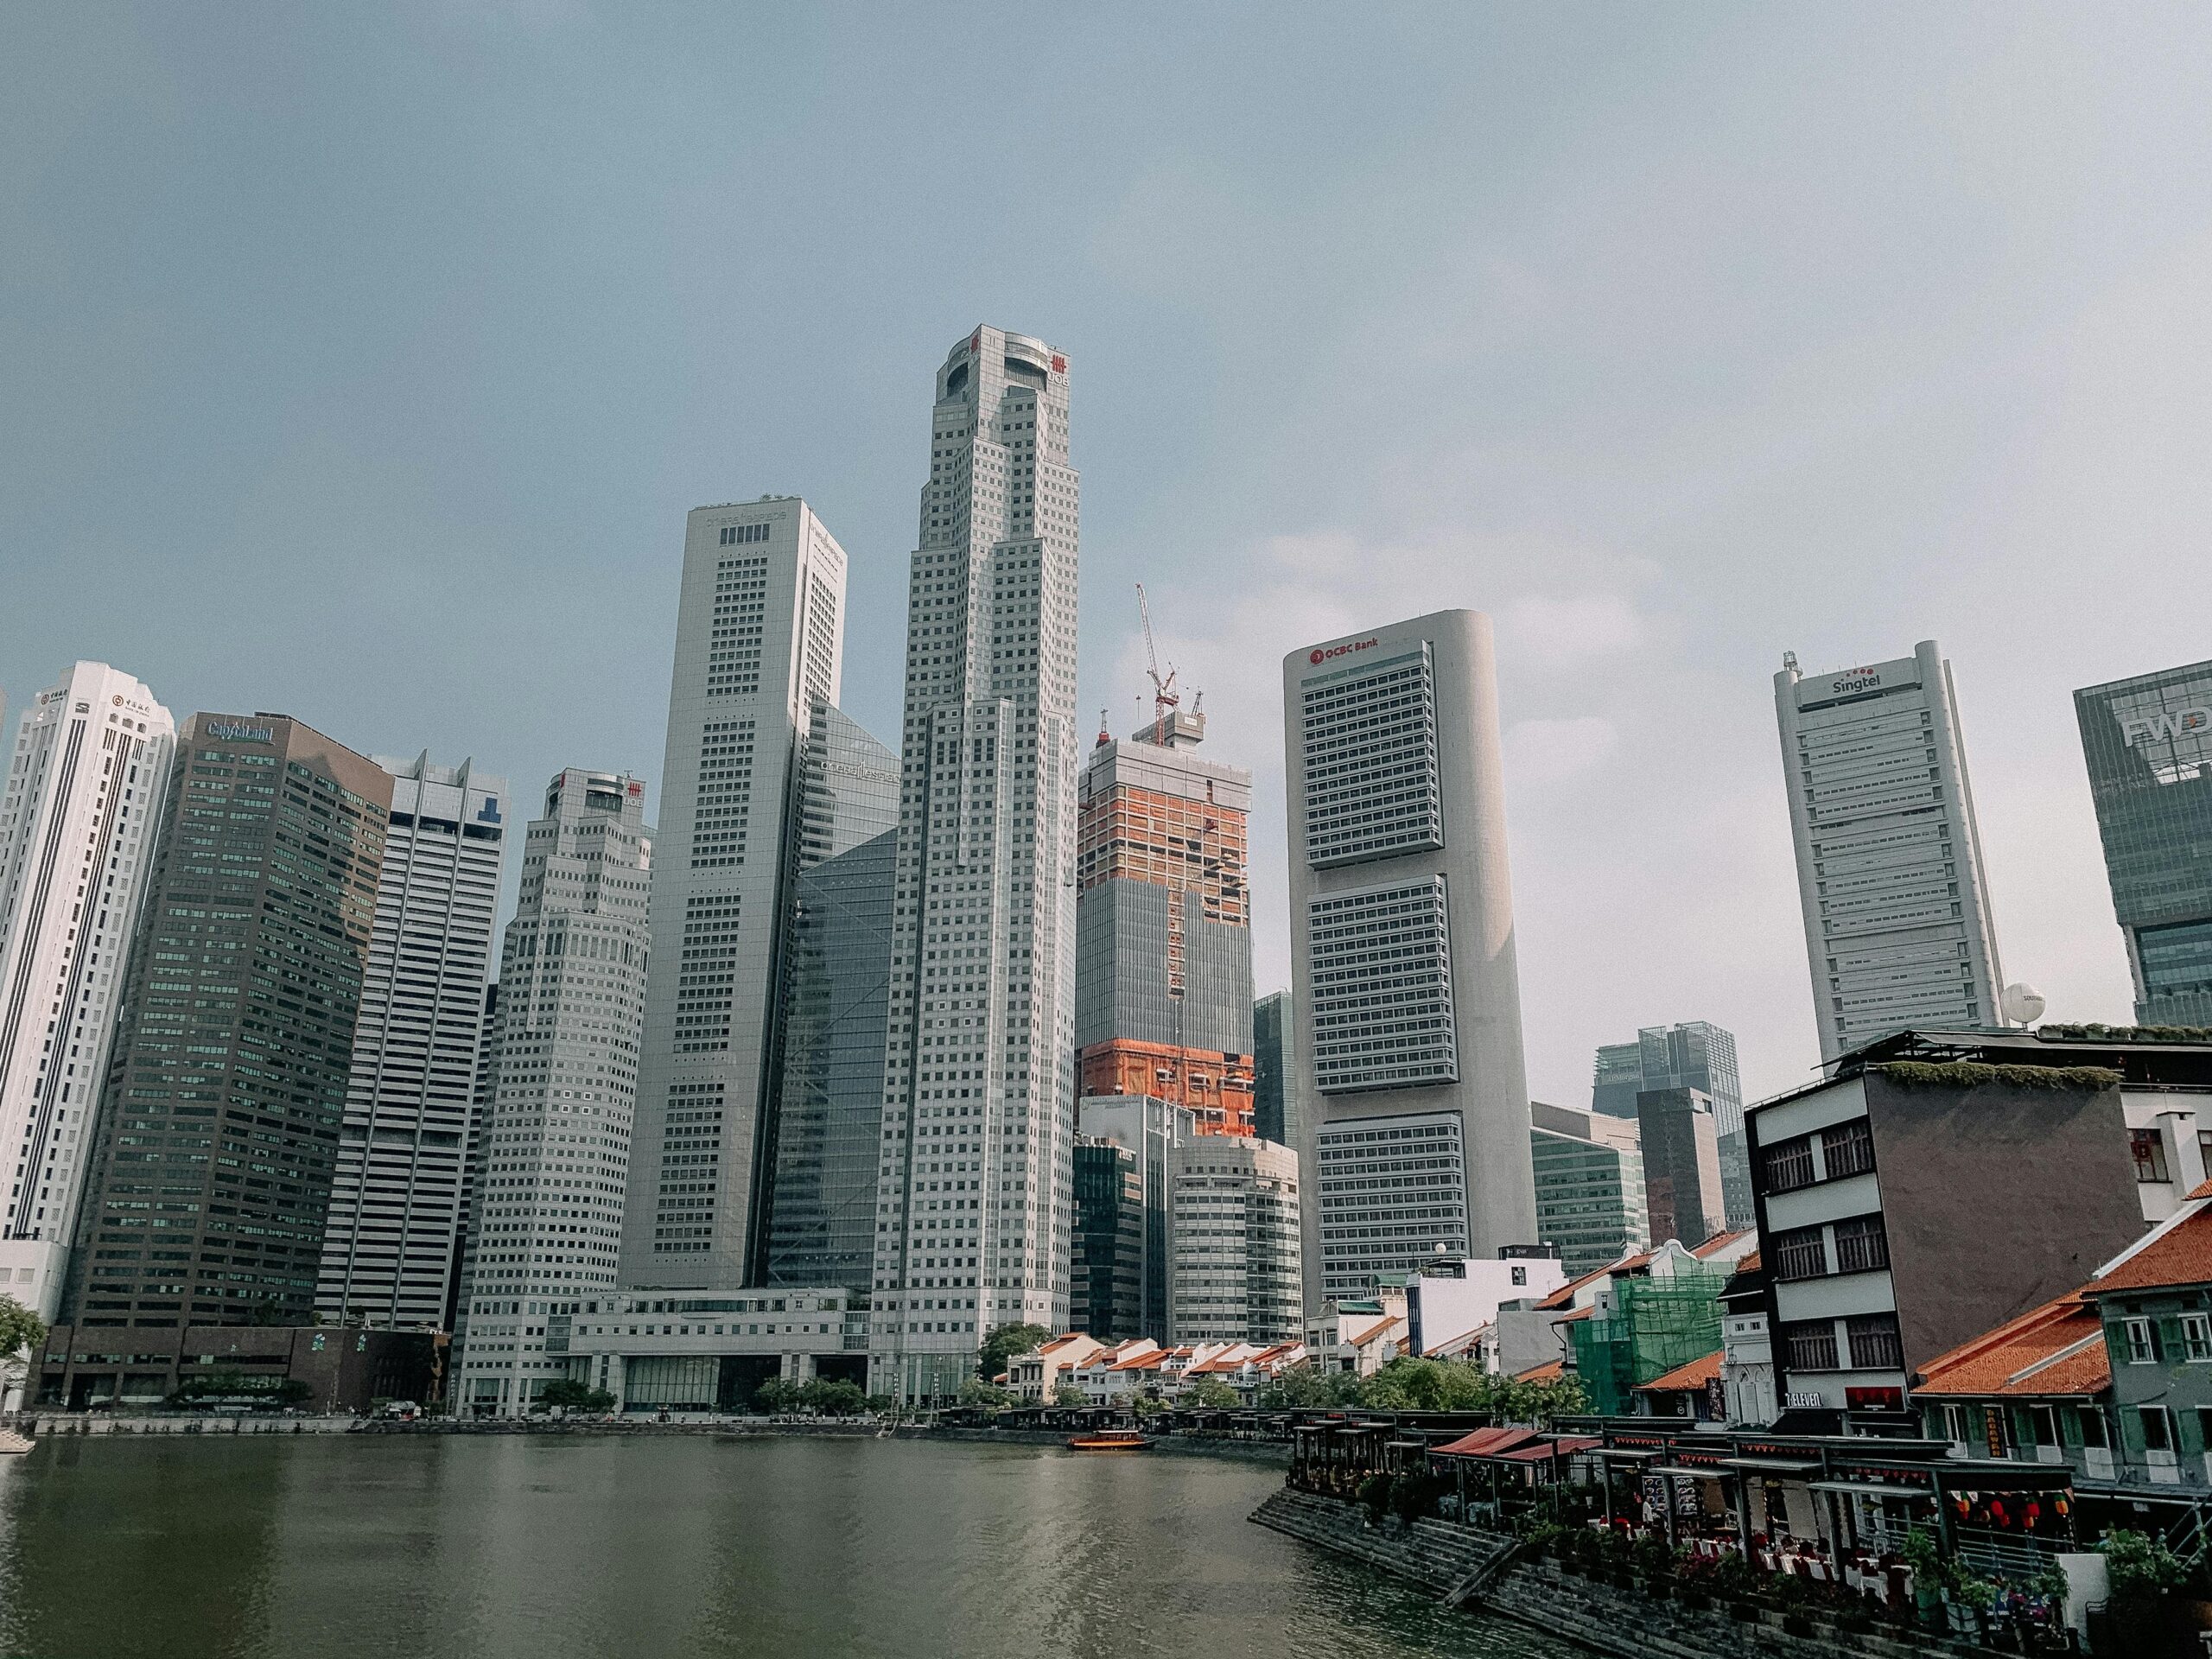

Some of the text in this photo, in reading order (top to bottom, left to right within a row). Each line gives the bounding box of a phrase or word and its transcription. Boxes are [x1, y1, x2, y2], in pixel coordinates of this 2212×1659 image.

[1046, 372, 1070, 387] UOB
[1325, 637, 1378, 658] OCBC Bank
[1833, 674, 1881, 693] Singtel
[2121, 706, 2212, 747] FWD
[624, 798, 644, 808] UOB
